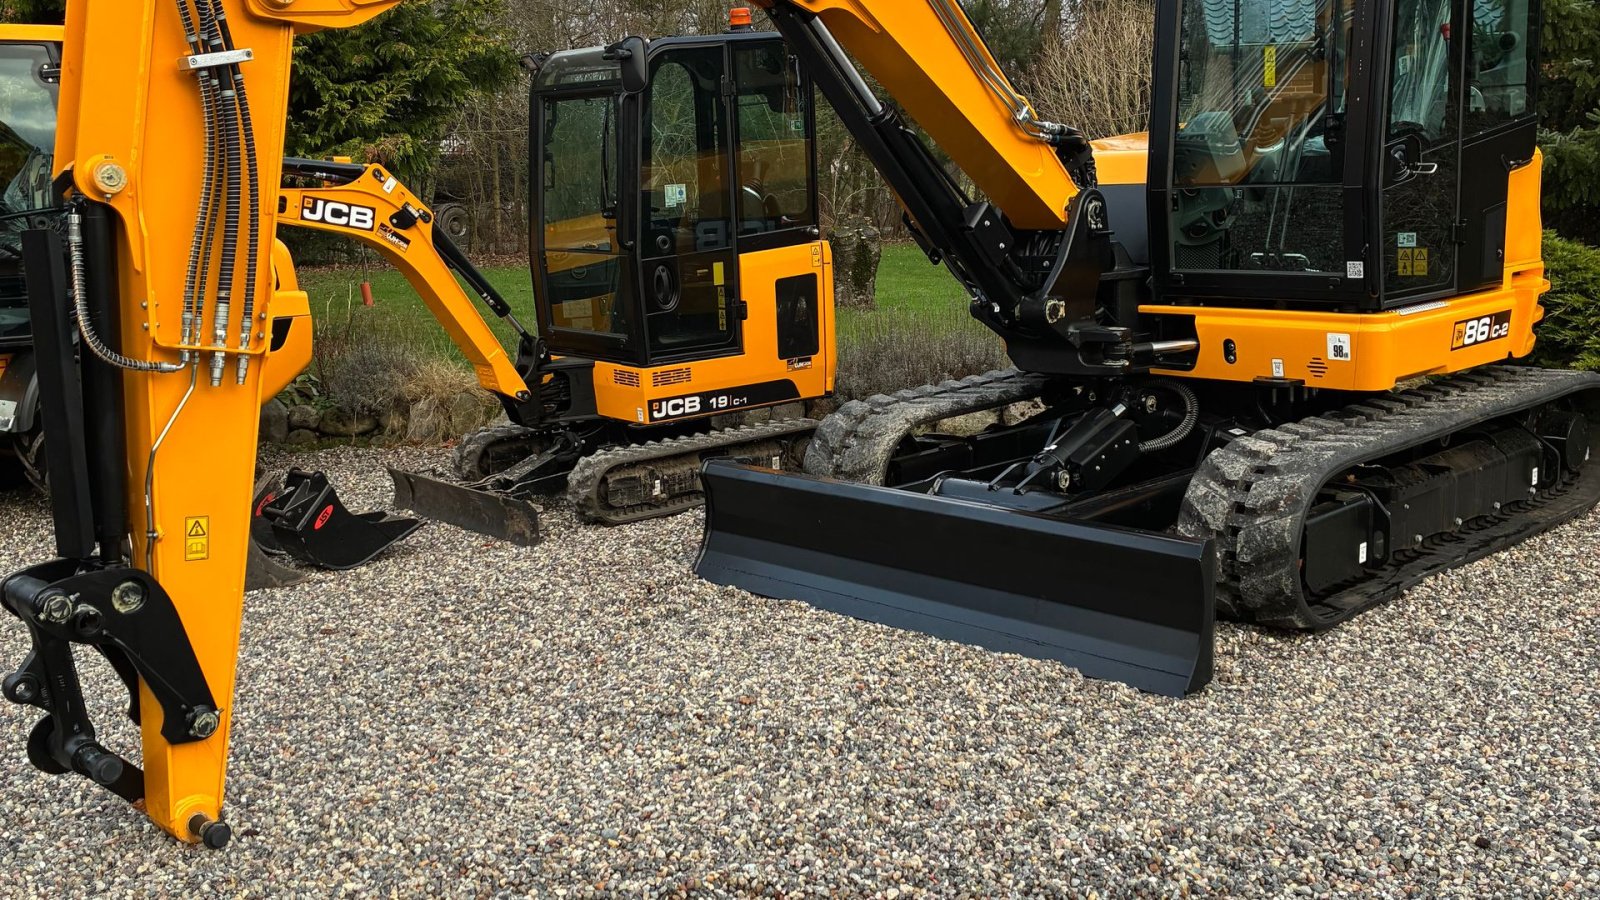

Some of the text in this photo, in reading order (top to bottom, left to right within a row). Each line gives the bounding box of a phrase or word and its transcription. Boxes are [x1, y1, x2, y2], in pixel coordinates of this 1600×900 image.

[303, 199, 374, 229] JCB
[1463, 317, 1491, 345] 86
[1333, 344, 1344, 358] 98
[653, 396, 701, 418] JCB
[709, 395, 728, 409] 19
